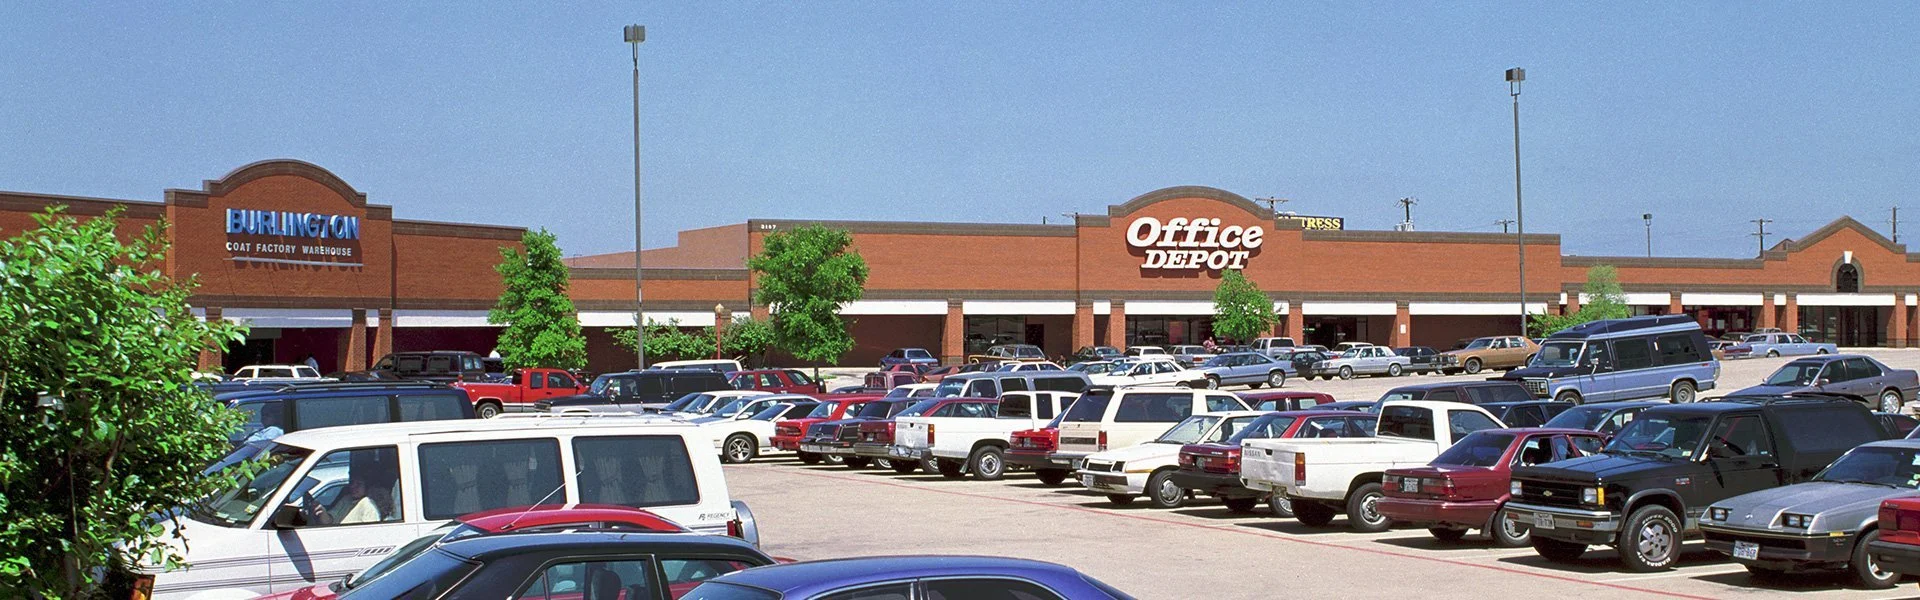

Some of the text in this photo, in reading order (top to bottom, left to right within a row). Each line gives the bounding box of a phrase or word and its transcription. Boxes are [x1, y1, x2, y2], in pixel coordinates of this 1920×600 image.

[226, 208, 359, 239] BURLINGTON
[1126, 216, 1263, 249] Office
[226, 241, 352, 257] COAT FACTORY WAREHOUSE
[1141, 250, 1250, 270] DEPOT
